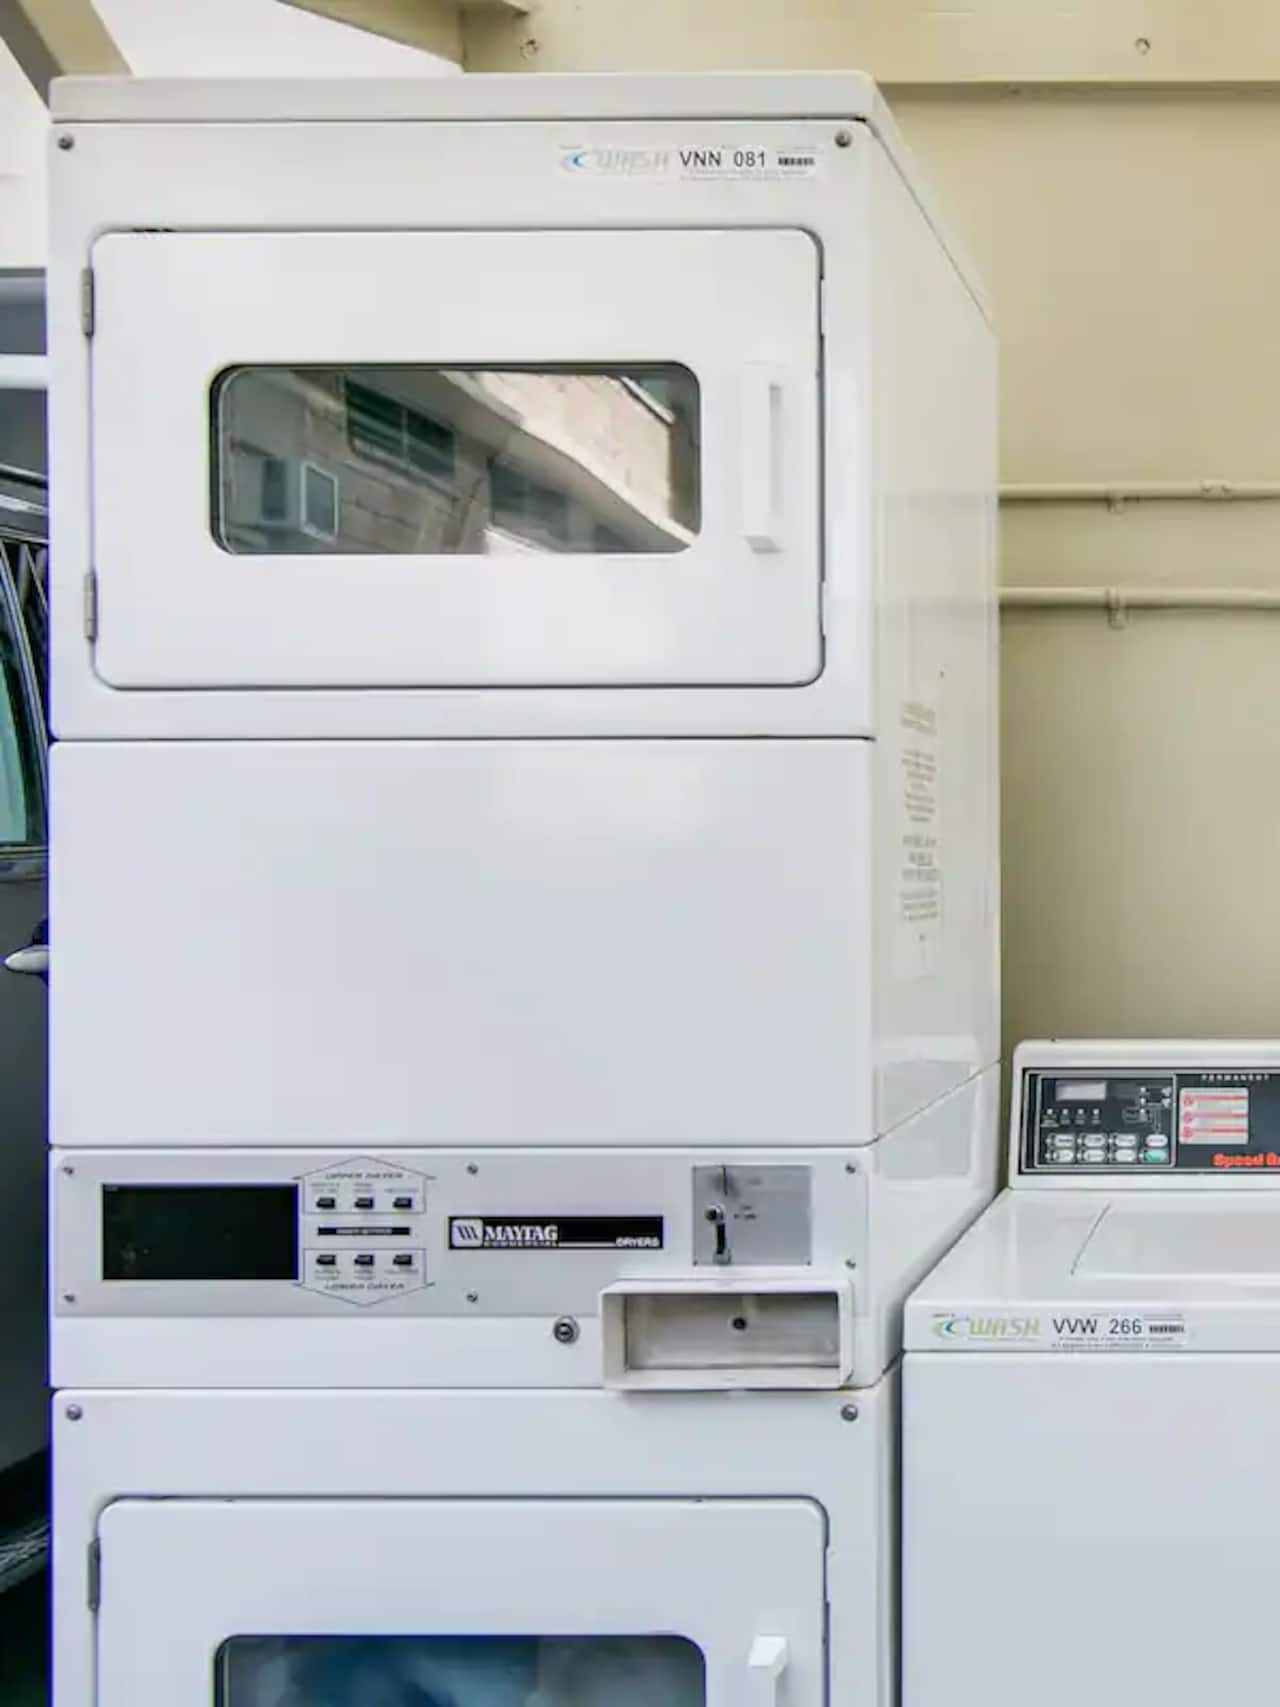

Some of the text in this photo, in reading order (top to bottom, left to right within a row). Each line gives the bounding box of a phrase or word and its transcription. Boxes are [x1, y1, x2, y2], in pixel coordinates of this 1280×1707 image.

[680, 151, 722, 167] VNN
[733, 151, 766, 167] 081
[1212, 1153, 1265, 1168] Speed
[484, 1224, 559, 1241] MAYTAG
[614, 1236, 660, 1247] DRYERS
[968, 1317, 1143, 1337] WASH VVW 266
